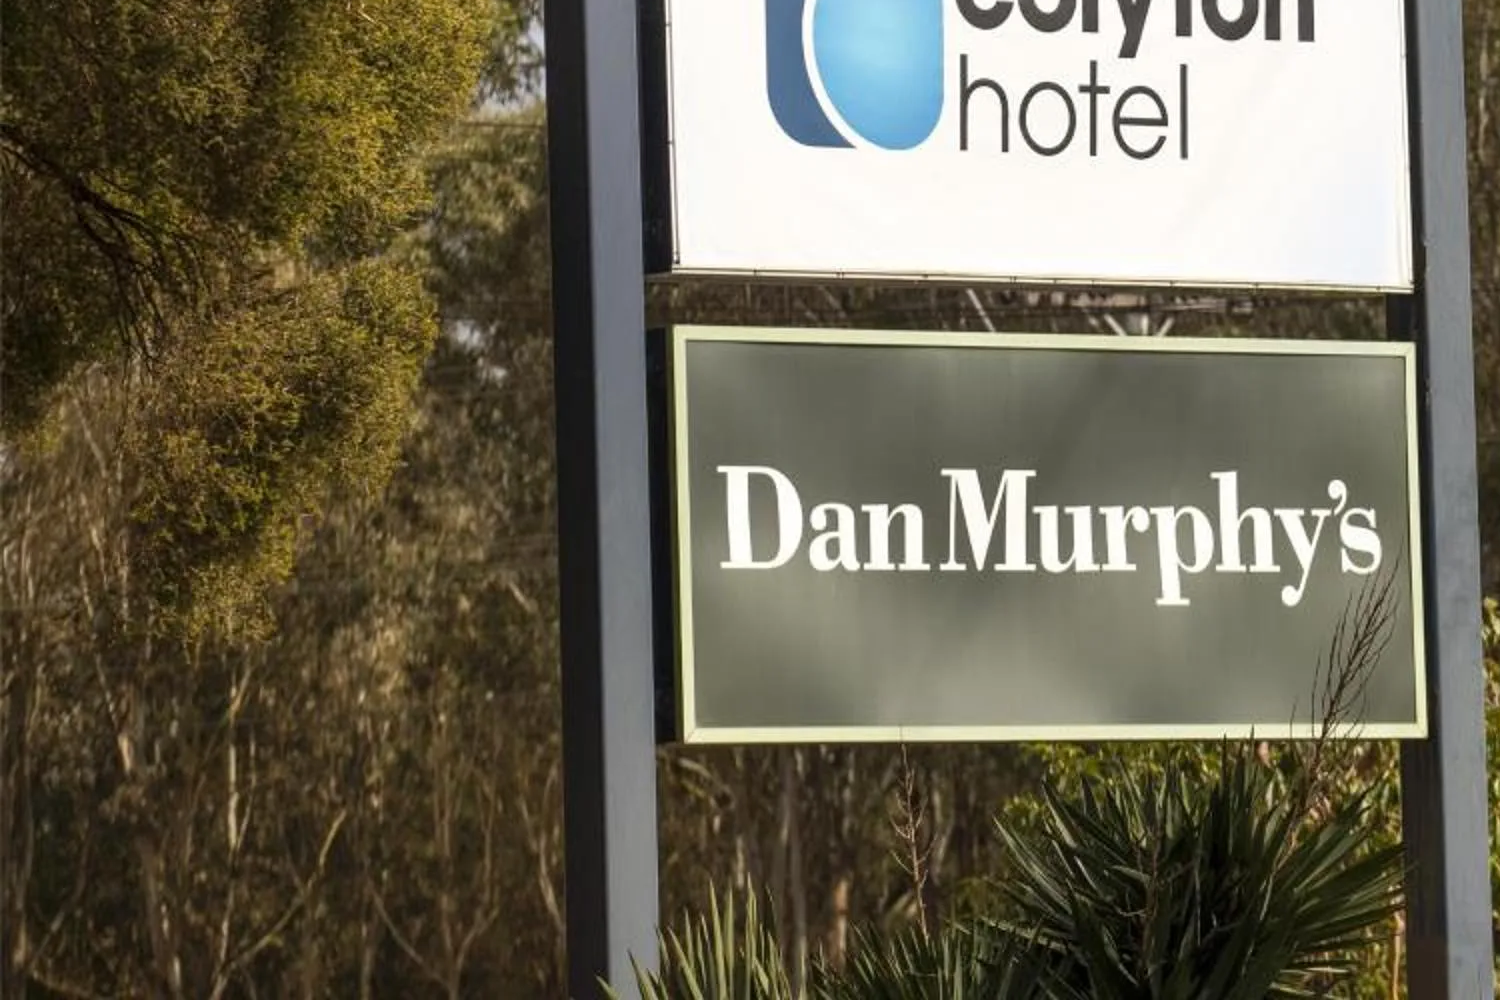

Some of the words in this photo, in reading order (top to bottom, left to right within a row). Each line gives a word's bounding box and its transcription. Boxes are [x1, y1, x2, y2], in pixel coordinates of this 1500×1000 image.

[959, 53, 1189, 161] hotel
[716, 464, 931, 573] Dan
[939, 467, 1384, 607] Murphy's
